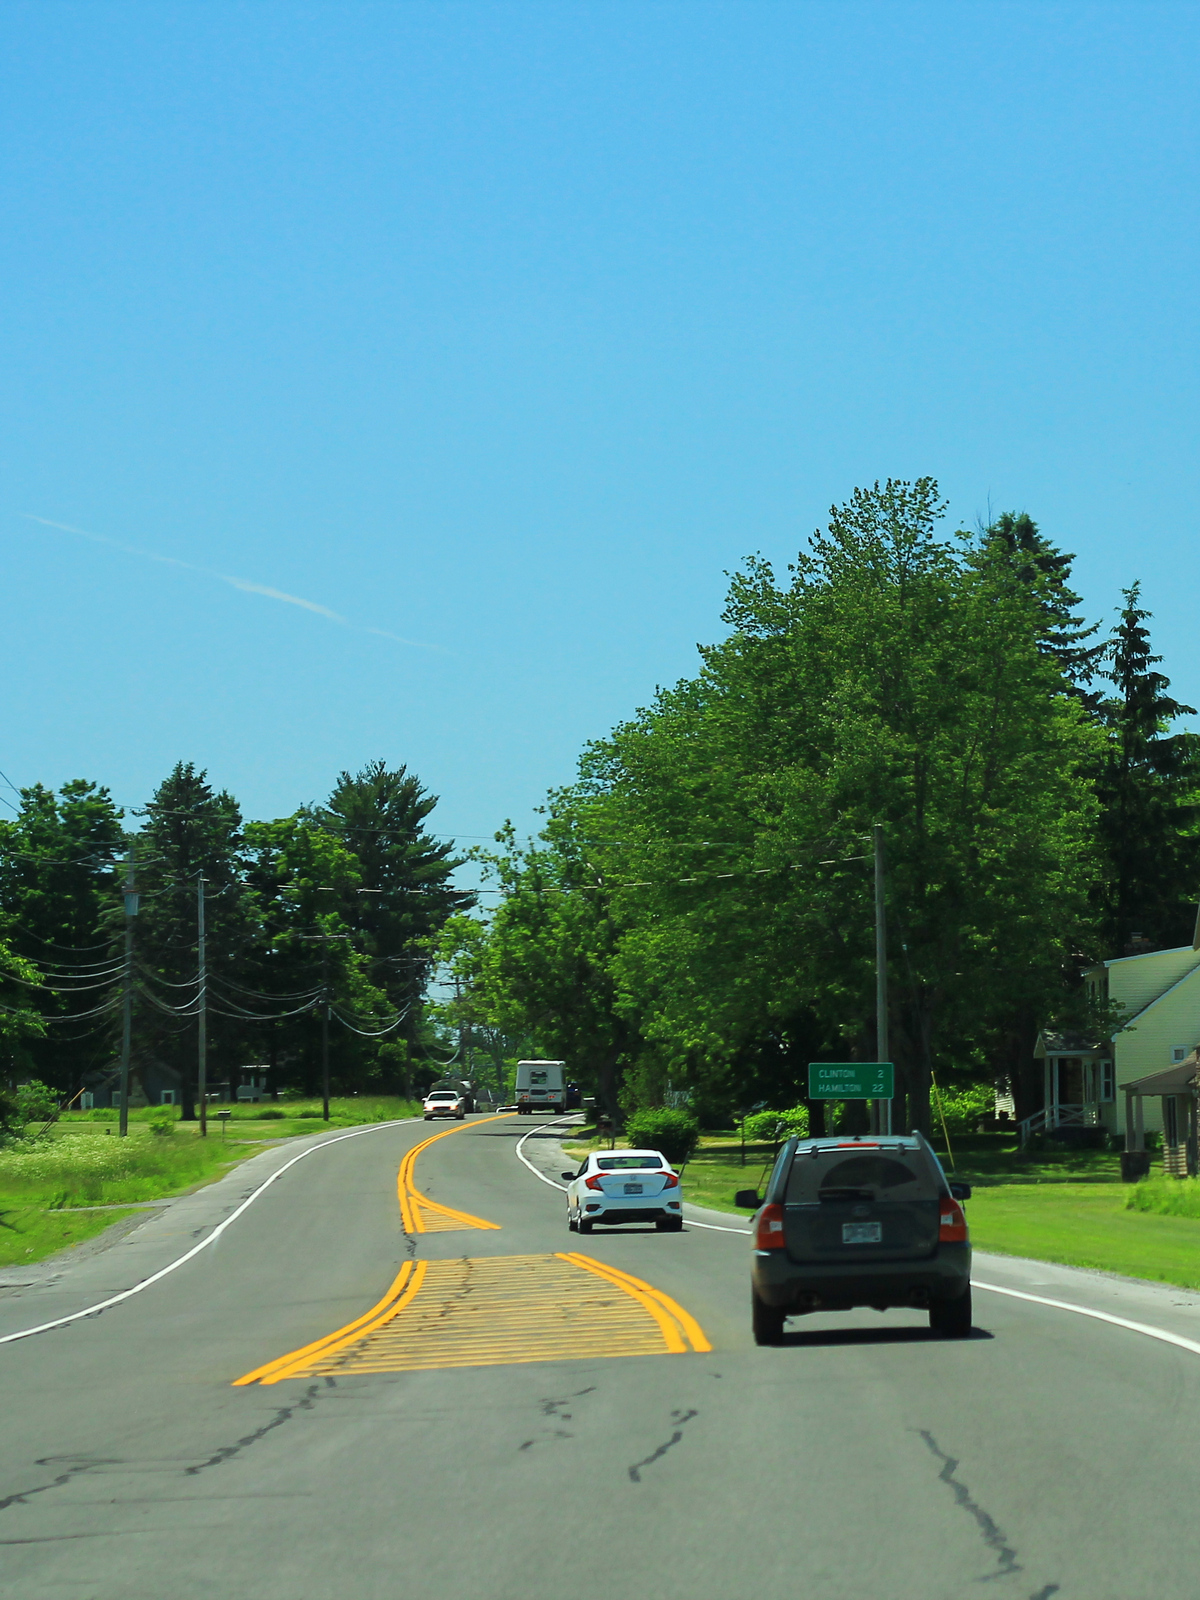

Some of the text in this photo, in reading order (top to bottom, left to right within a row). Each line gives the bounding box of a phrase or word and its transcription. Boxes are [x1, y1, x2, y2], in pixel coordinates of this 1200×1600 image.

[818, 1069, 884, 1078] CLINTON 2
[818, 1083, 884, 1093] HAMILTON 22
